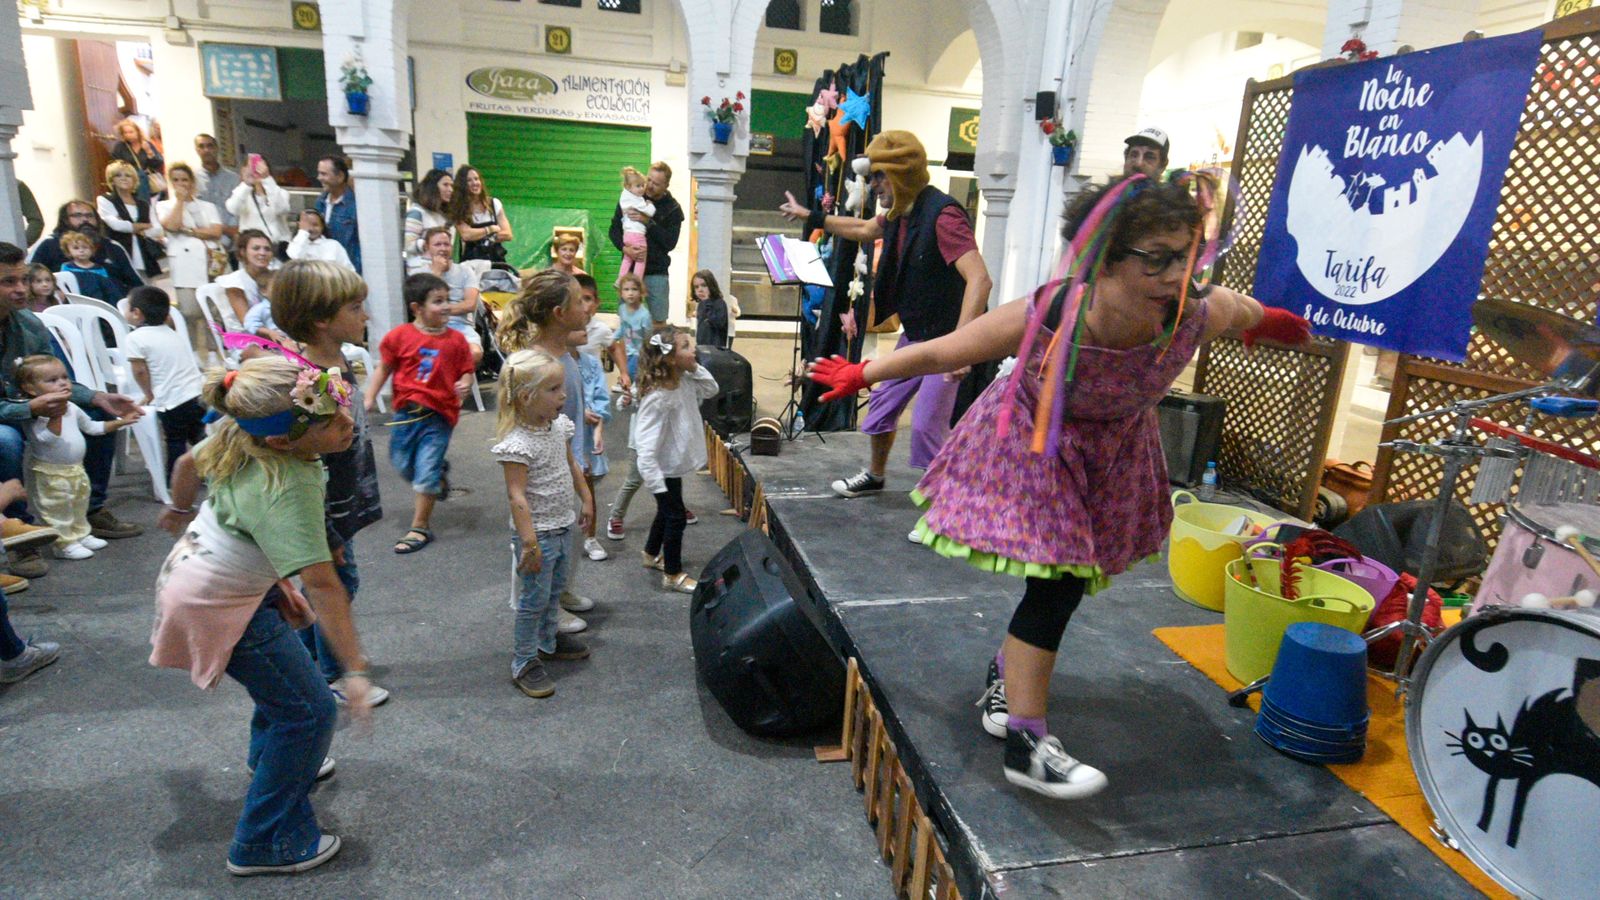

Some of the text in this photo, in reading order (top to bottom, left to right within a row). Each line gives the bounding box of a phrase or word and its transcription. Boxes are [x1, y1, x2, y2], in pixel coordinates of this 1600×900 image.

[551, 32, 564, 47] 21
[779, 55, 792, 67] 22
[1385, 64, 1403, 84] La
[1359, 77, 1433, 111] Noche
[516, 105, 574, 117] VERDURAS
[1379, 114, 1403, 131] en
[1344, 125, 1431, 160] Blanco
[1325, 249, 1389, 293] Tarifa
[1334, 284, 1357, 298] 2022
[1303, 303, 1387, 335] 8 de Octubre
